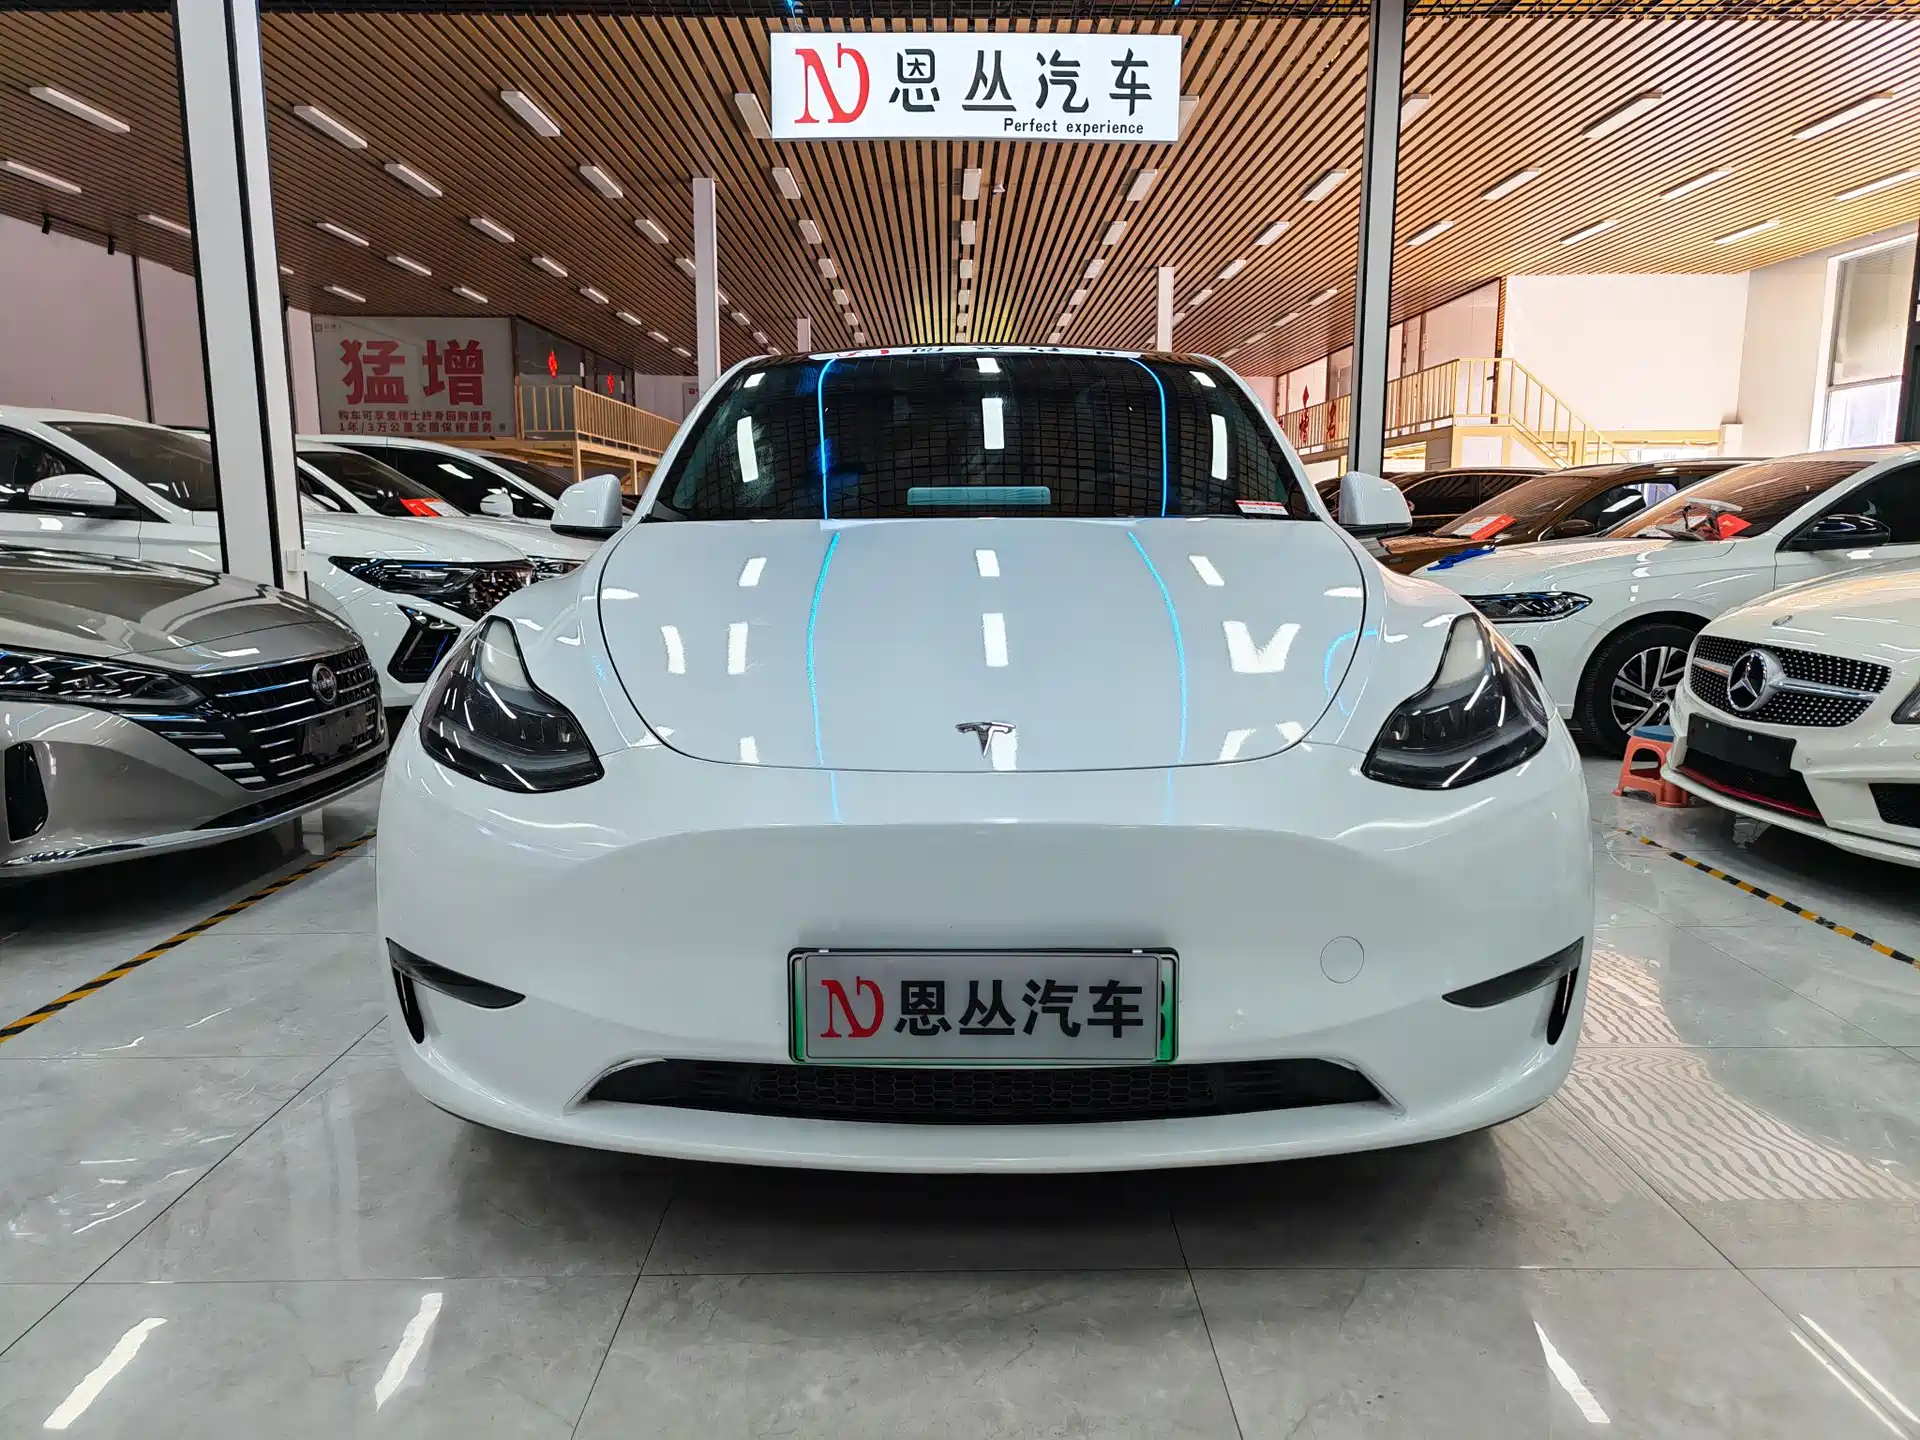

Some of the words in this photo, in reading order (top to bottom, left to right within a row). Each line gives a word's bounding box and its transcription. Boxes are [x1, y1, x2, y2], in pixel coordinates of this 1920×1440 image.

[889, 47, 1152, 117] 恩丛汽车
[1004, 118, 1058, 133] Perfect
[1066, 121, 1144, 135] experience
[340, 339, 485, 406] 猛增
[894, 979, 1144, 1038] 恩丛汽车
